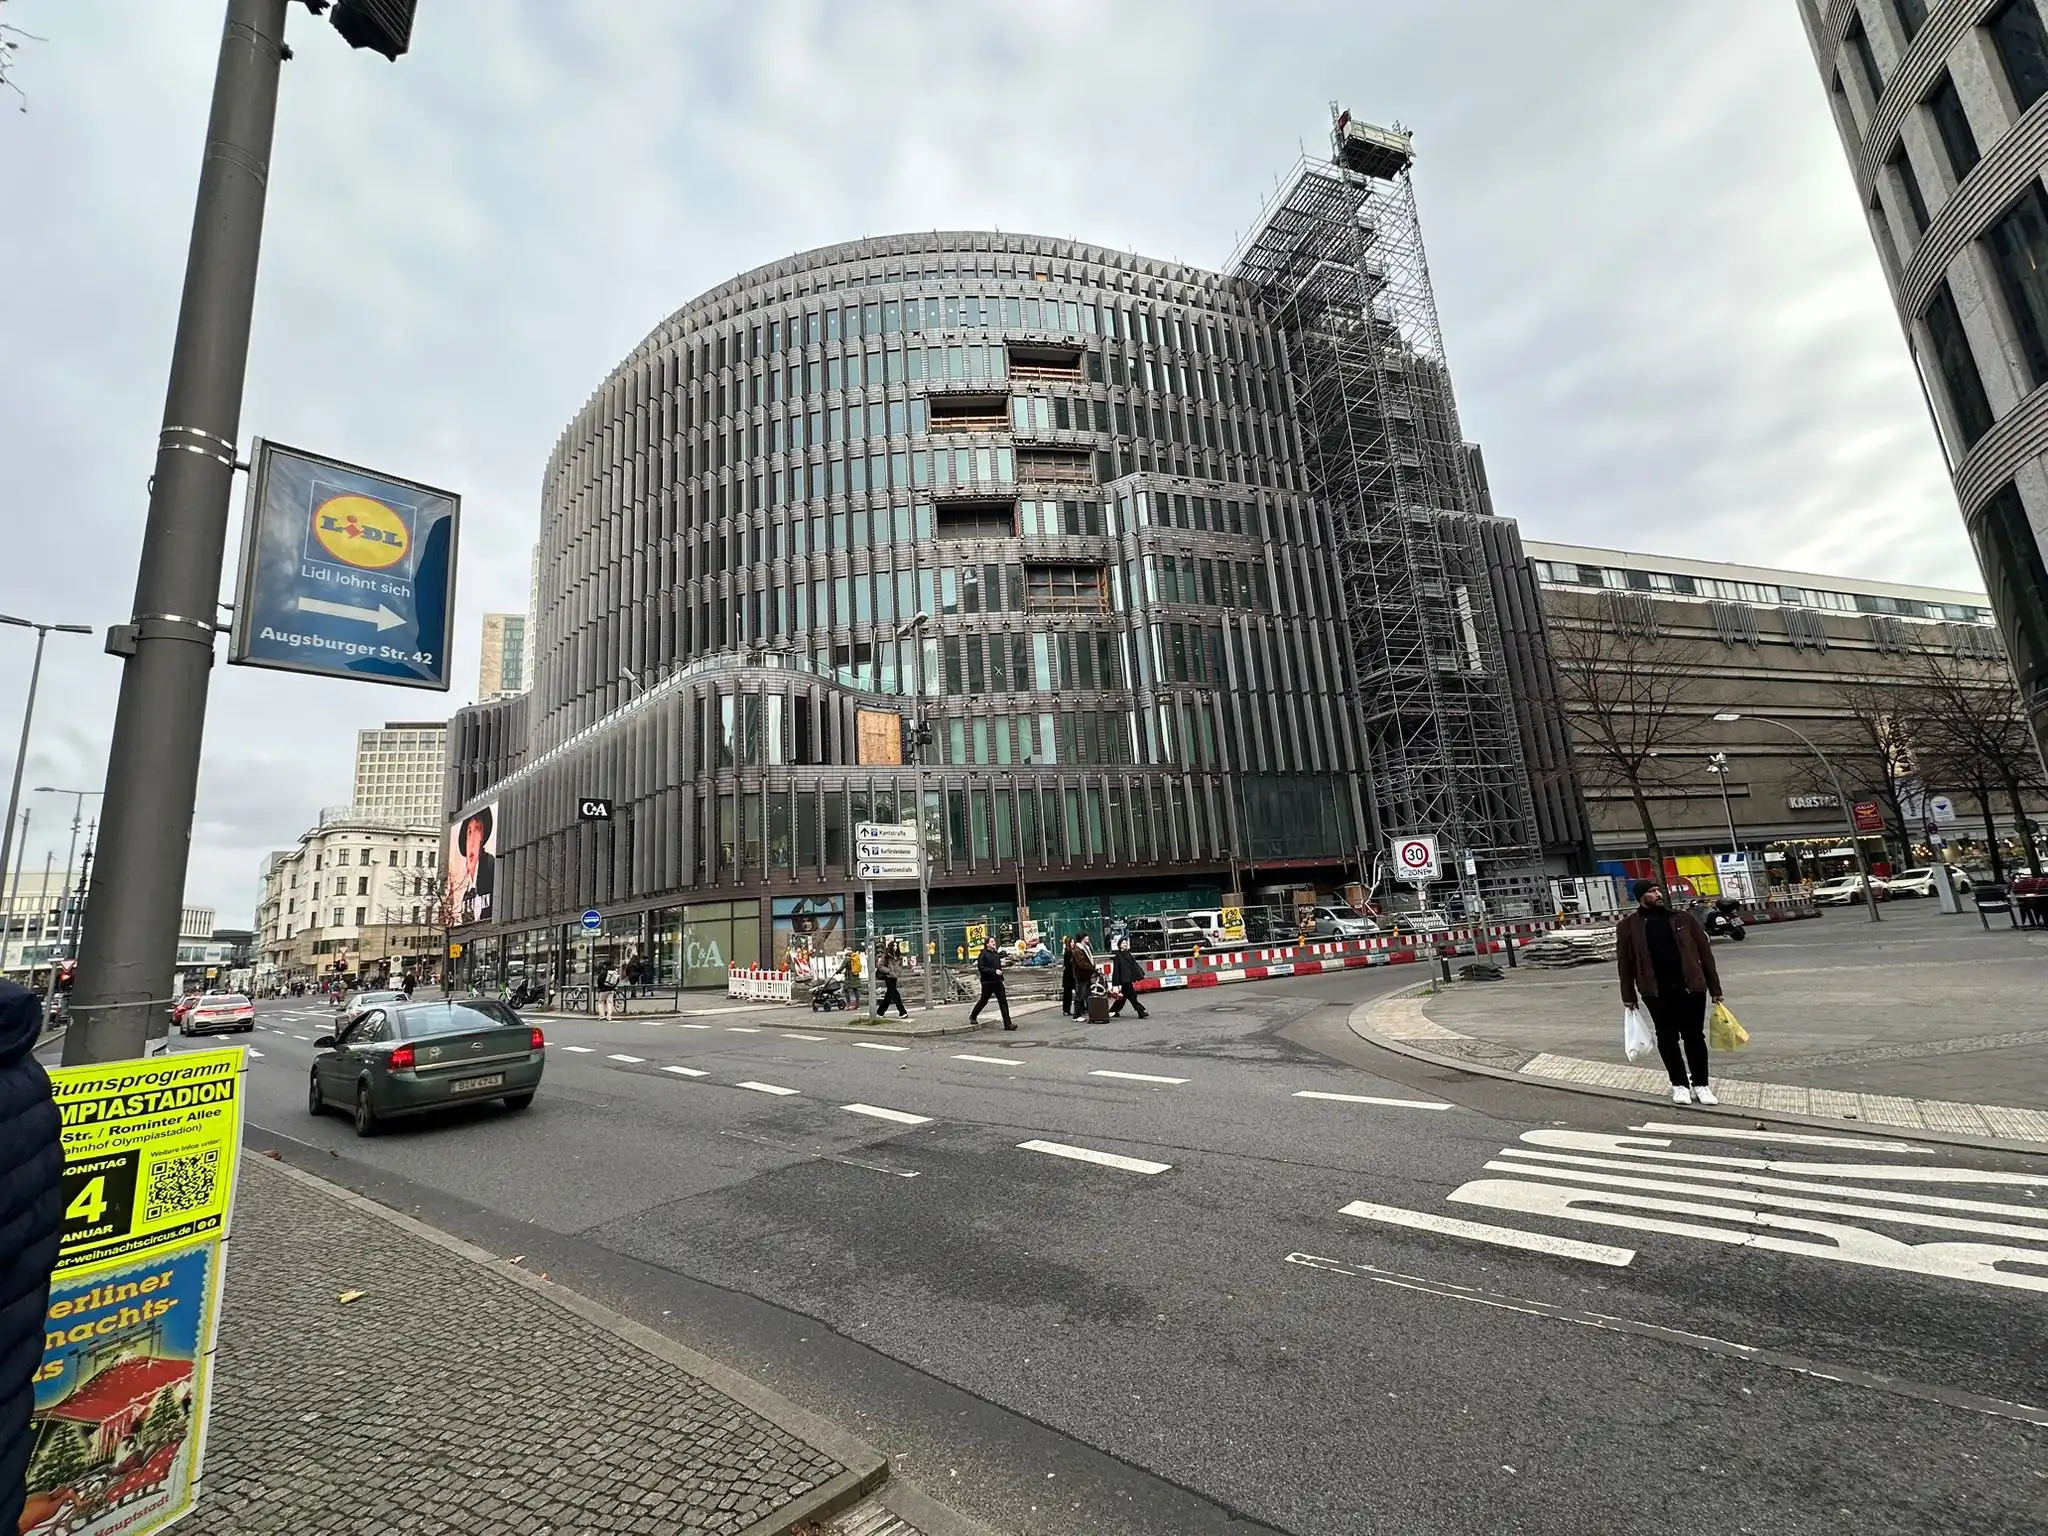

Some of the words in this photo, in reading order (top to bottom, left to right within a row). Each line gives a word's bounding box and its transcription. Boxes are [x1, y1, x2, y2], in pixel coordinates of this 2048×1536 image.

[302, 565, 331, 582] Lidl
[336, 571, 377, 591] lohnt
[381, 582, 410, 598] sich
[260, 626, 376, 655] Augsburger
[380, 645, 408, 661] Str.
[412, 651, 433, 665] 42
[582, 802, 608, 816] C&A
[1407, 848, 1424, 861] 30
[687, 940, 725, 968] C&A
[62, 1131, 93, 1143] Str.
[108, 1115, 184, 1136] Rominter
[186, 1107, 222, 1122] Allee
[112, 1123, 203, 1148] Olympiastadion)
[150, 1146, 180, 1158] Weitere
[181, 1142, 200, 1152] Infos
[62, 1157, 127, 1176] ONNTAG
[55, 1225, 192, 1268] er-weihnachtscircus.de
[48, 1269, 175, 1320] erliner
